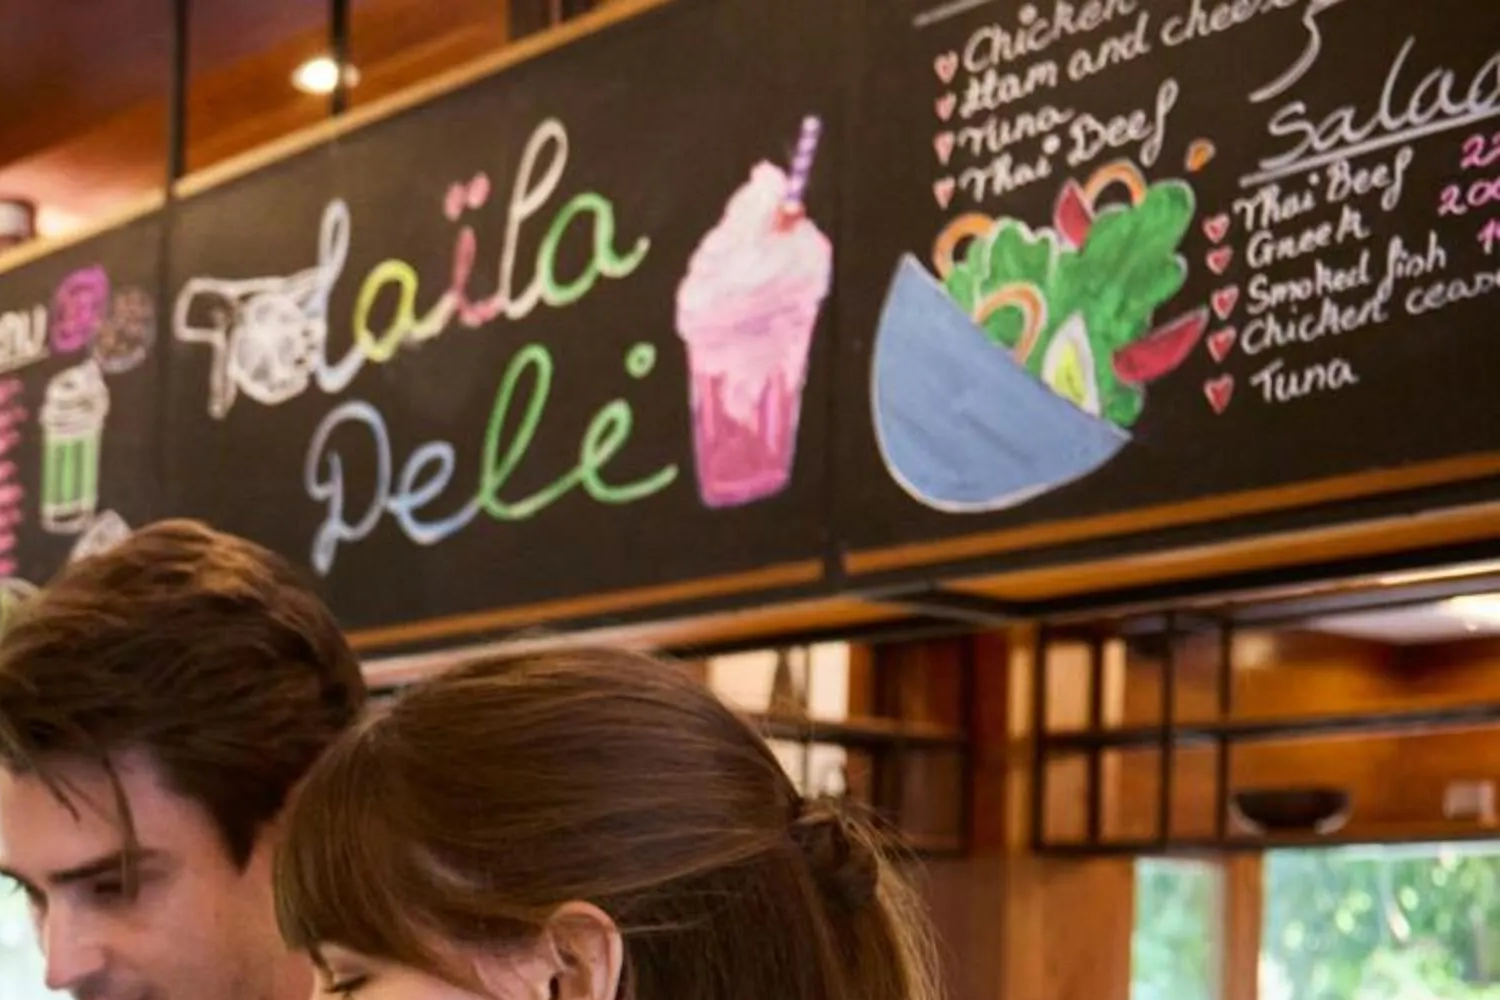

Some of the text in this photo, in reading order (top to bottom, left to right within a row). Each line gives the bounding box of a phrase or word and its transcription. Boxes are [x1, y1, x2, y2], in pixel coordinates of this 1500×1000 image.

[1067, 11, 1152, 82] and
[1160, 0, 1298, 46] chee
[957, 105, 1077, 156] Tuna
[958, 133, 1062, 202] Thai
[1233, 172, 1317, 232] Thai
[1325, 145, 1414, 212] Beef
[1245, 248, 1372, 315] Smoked
[1375, 229, 1447, 304] fish
[1240, 295, 1389, 355] Chicken
[1248, 356, 1361, 404] Tuna
[305, 343, 678, 577] Deli
